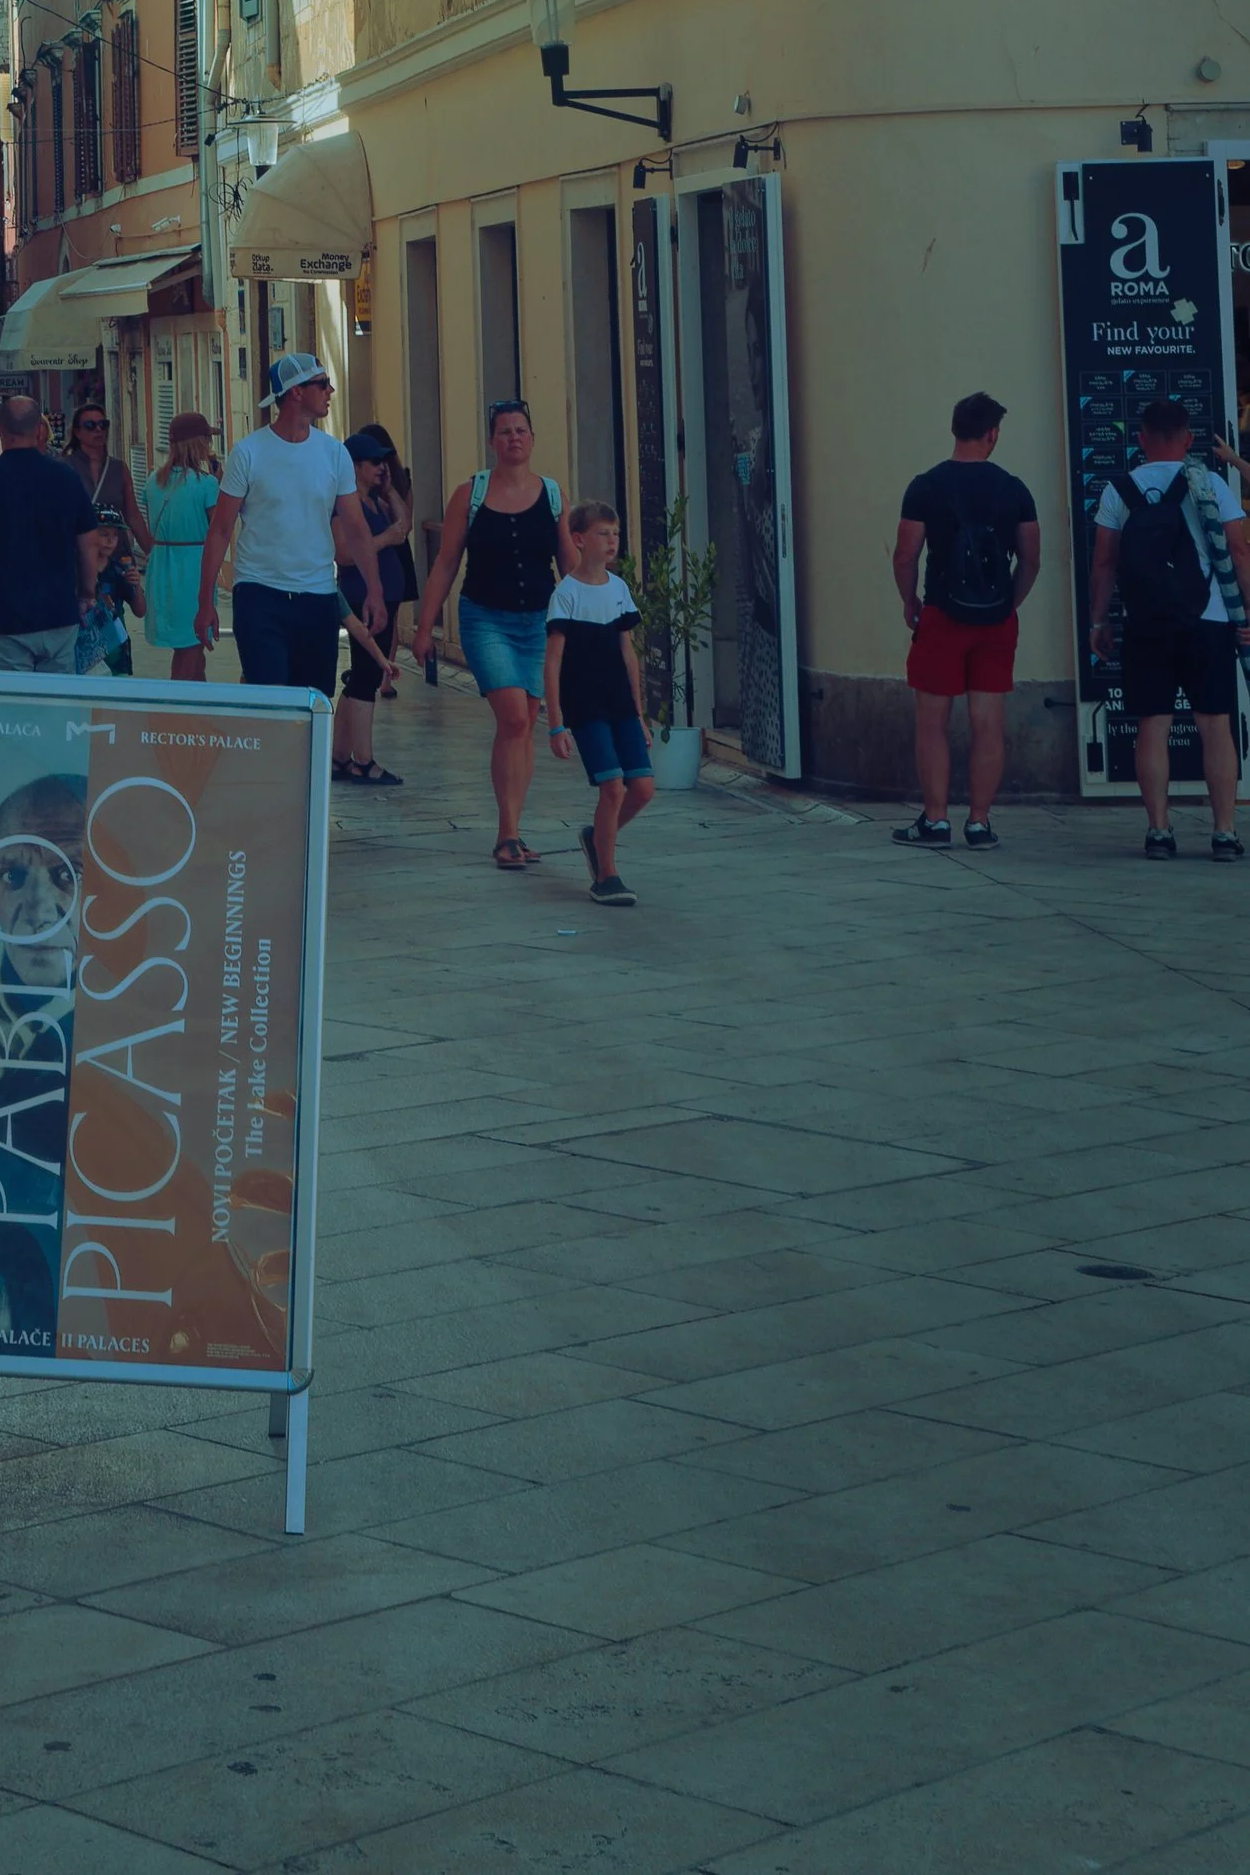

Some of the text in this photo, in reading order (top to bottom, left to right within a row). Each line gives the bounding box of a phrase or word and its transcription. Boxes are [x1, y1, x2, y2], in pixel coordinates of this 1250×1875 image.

[300, 259, 352, 272] Exchange
[321, 253, 350, 262] Money
[1110, 281, 1170, 296] ROMA
[1091, 322, 1195, 346] Find your
[30, 353, 88, 367] Souvenir Shop
[1107, 345, 1196, 355] NEW FAVOURITE.
[140, 731, 261, 751] RECTOR'S PALACE
[223, 850, 247, 988] BEGINNINGS
[220, 992, 240, 1045] NEW
[61, 776, 196, 1307] PICASSO
[244, 939, 272, 1158] The Lake Collection
[212, 1068, 237, 1177] POČETAK
[211, 1183, 232, 1243] NOVI
[77, 1334, 150, 1354] PALACES
